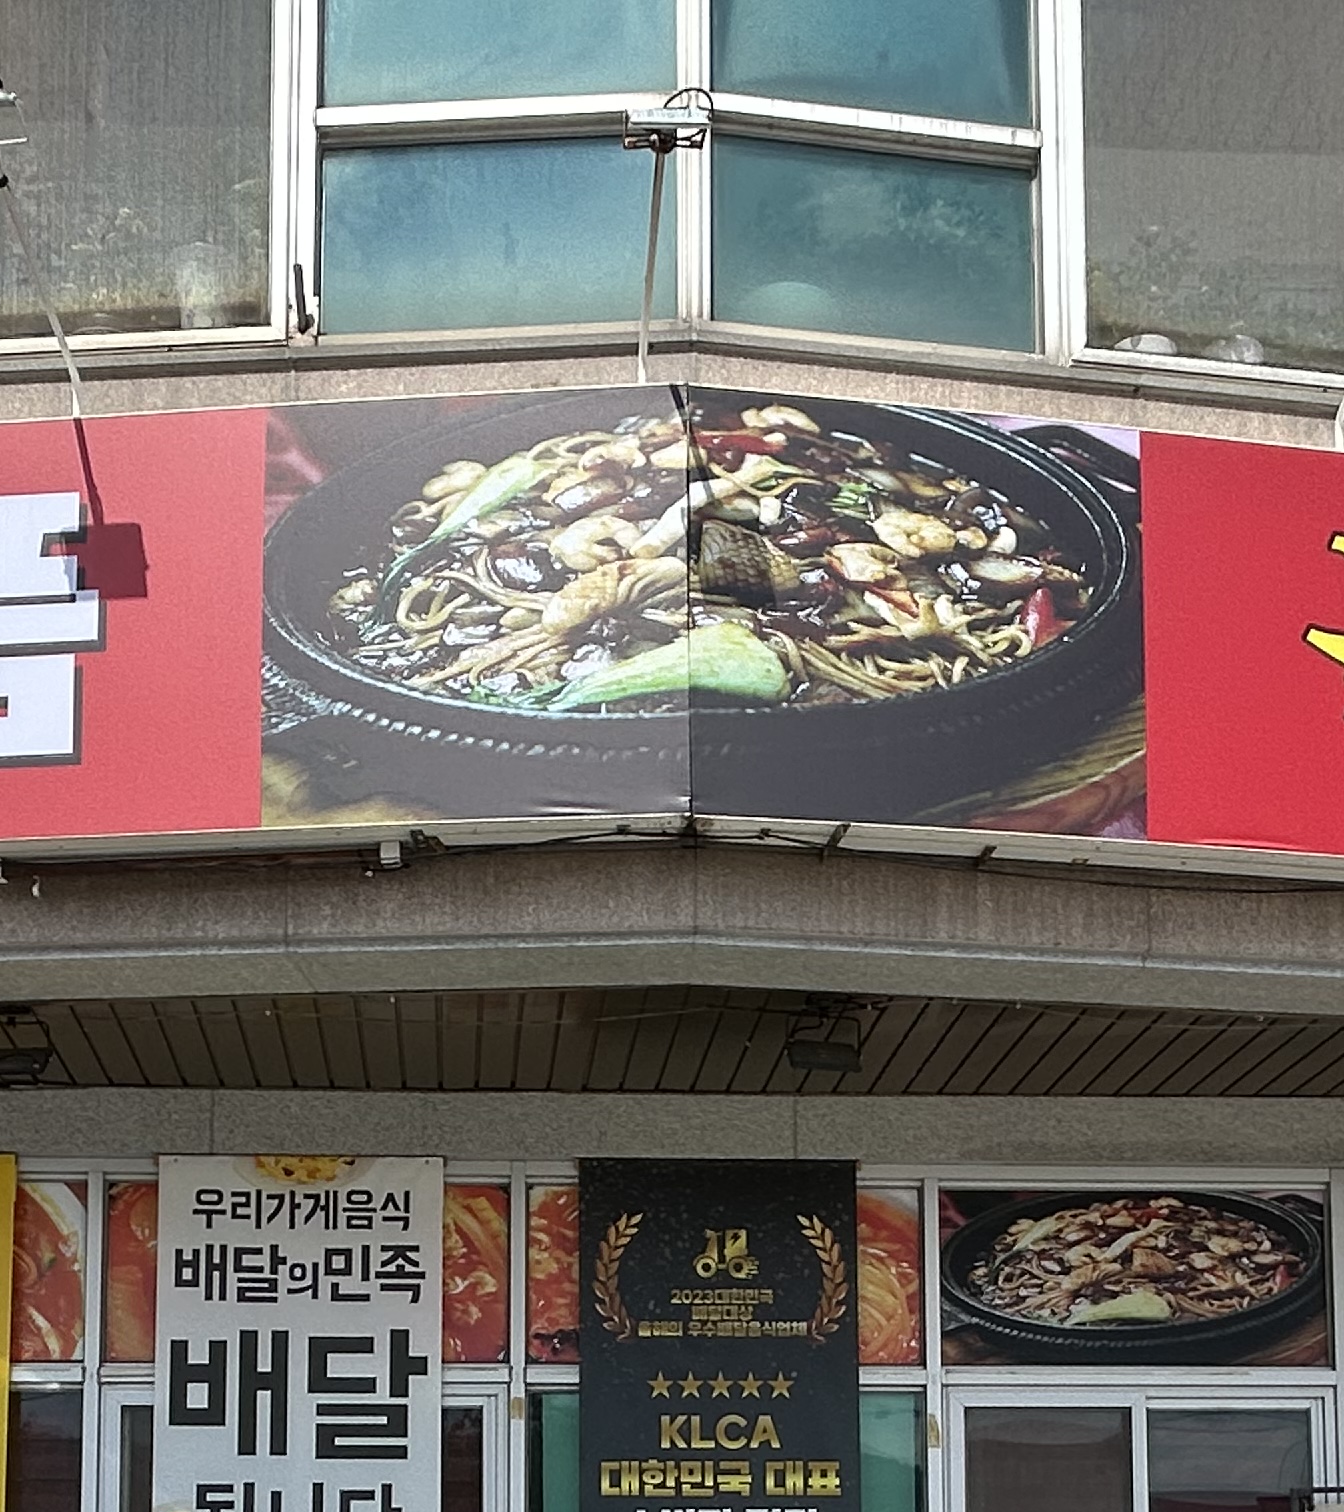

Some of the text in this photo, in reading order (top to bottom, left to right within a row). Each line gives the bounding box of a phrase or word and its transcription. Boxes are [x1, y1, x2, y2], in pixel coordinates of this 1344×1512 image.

[192, 1188, 411, 1231] 우리가게음식
[173, 1243, 426, 1304] 배달의민족
[168, 1328, 428, 1460] 배달
[660, 1414, 782, 1450] KLCA
[600, 1458, 843, 1497] 대한민국 대표
